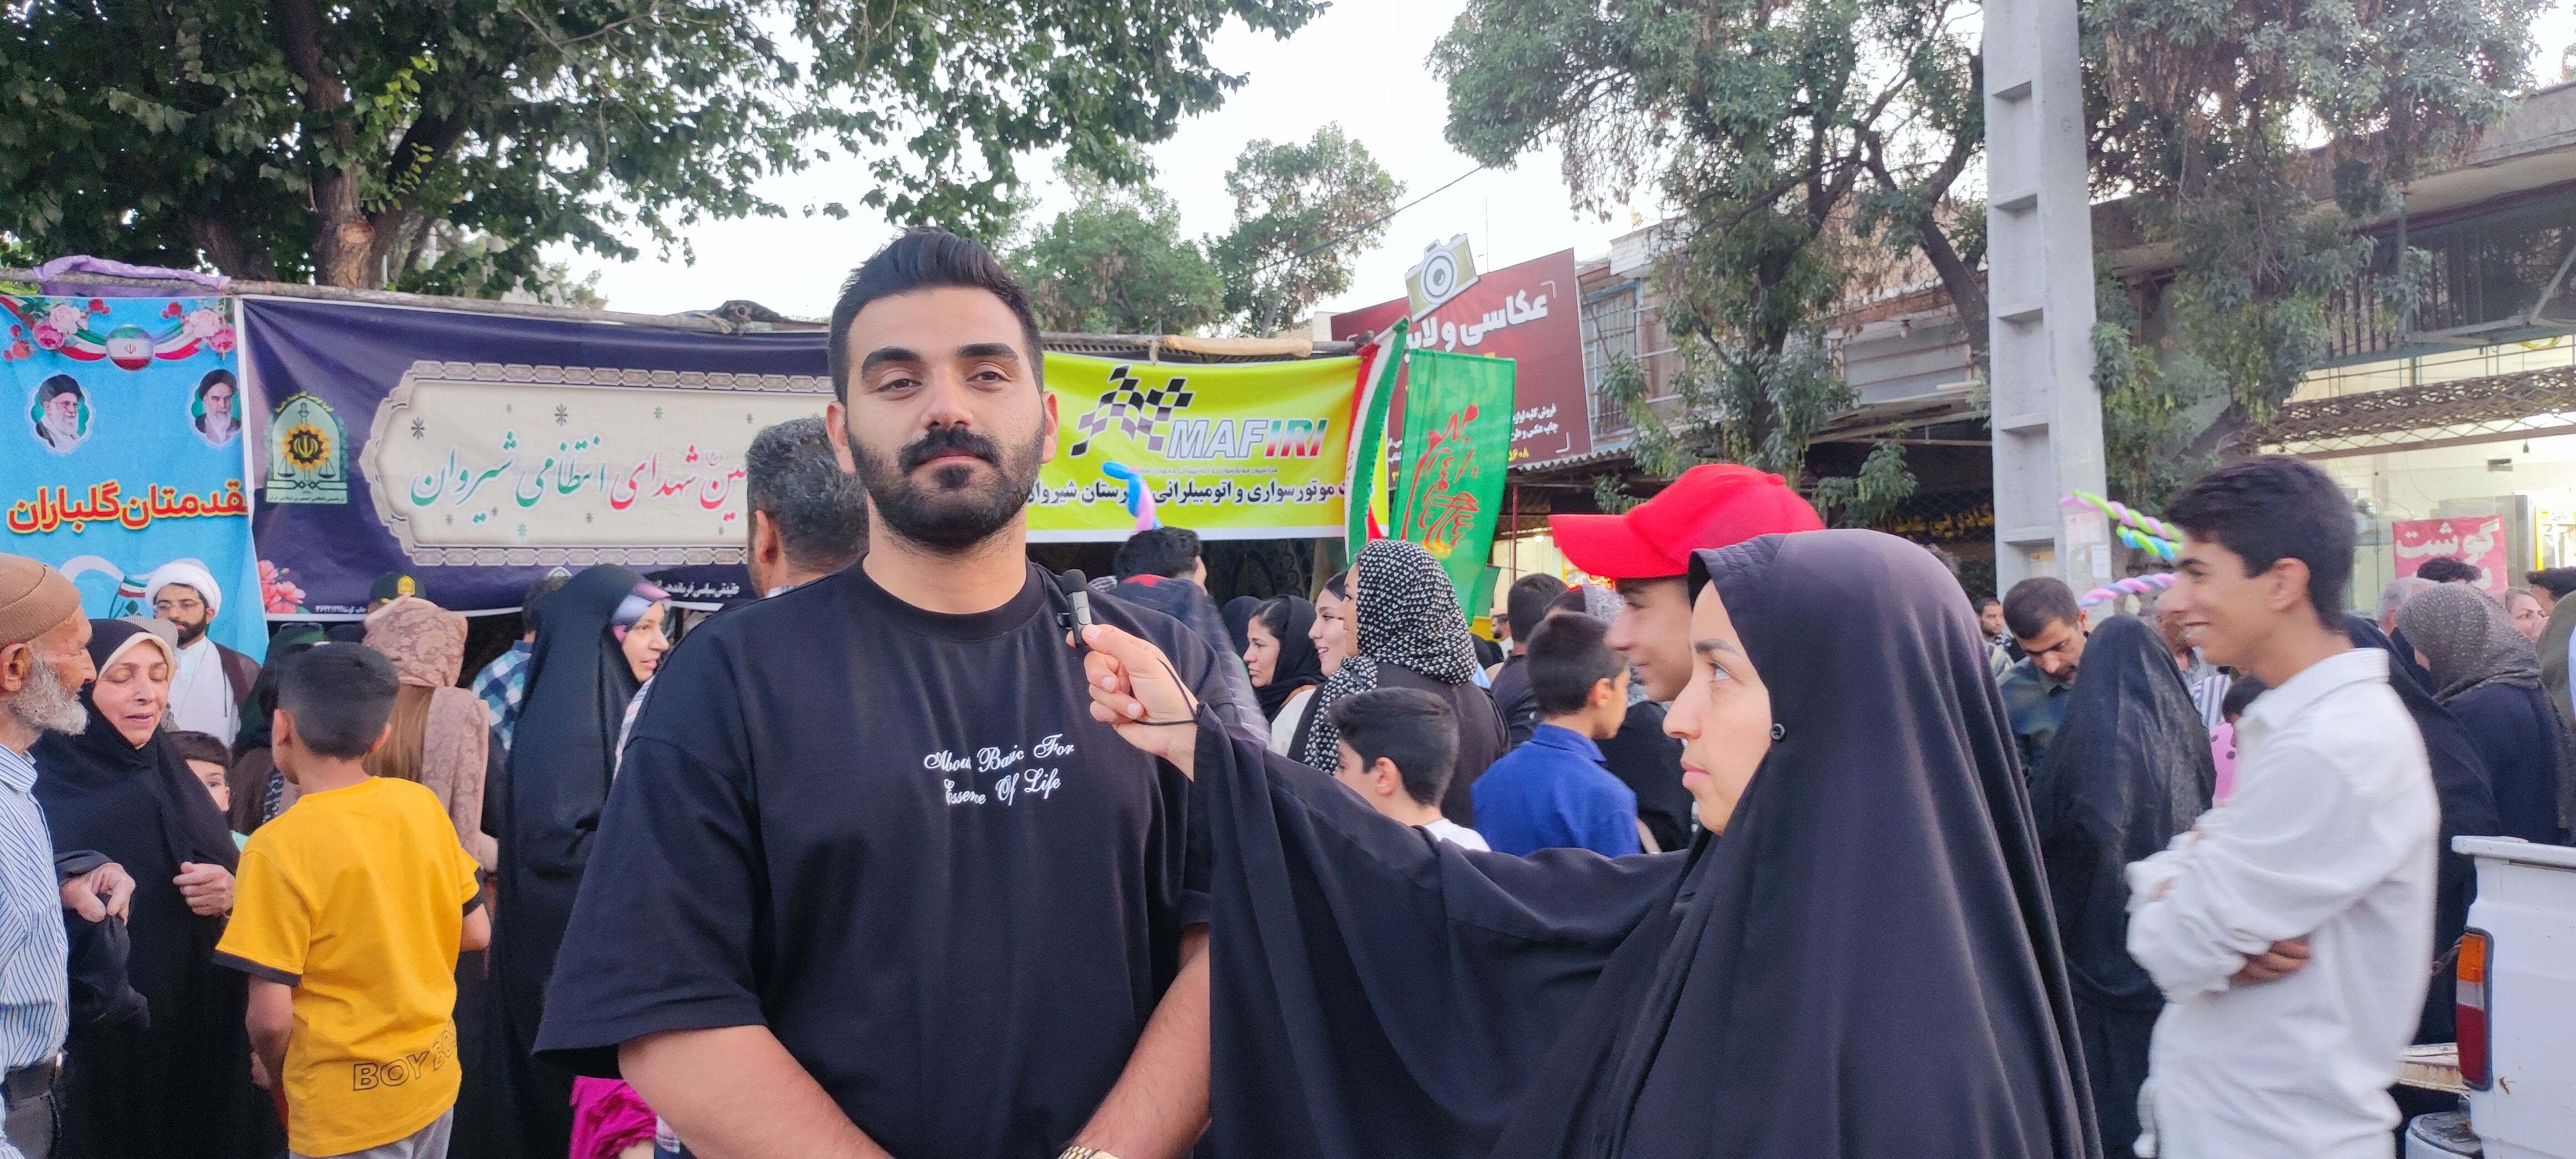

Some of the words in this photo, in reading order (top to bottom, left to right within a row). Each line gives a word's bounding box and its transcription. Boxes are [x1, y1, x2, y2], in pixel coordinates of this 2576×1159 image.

[1441, 320, 1457, 353] و
[1459, 289, 1549, 347] عکاسی
[1166, 419, 1329, 459] MAFIRI
[411, 431, 517, 524] شیروان
[516, 435, 605, 506] انتظامی
[610, 444, 698, 510] شهدای
[8, 480, 121, 533] گلباران
[120, 480, 248, 528] قدمتان
[1081, 480, 1128, 503] رستان
[1153, 480, 1231, 503] اتومبیلرانی
[1235, 487, 1242, 503] و
[2396, 517, 2500, 566] گوشت
[1033, 733, 1075, 759] For
[995, 772, 1020, 806] Of
[1024, 767, 1062, 800] Life
[353, 1050, 431, 1091] BOY
